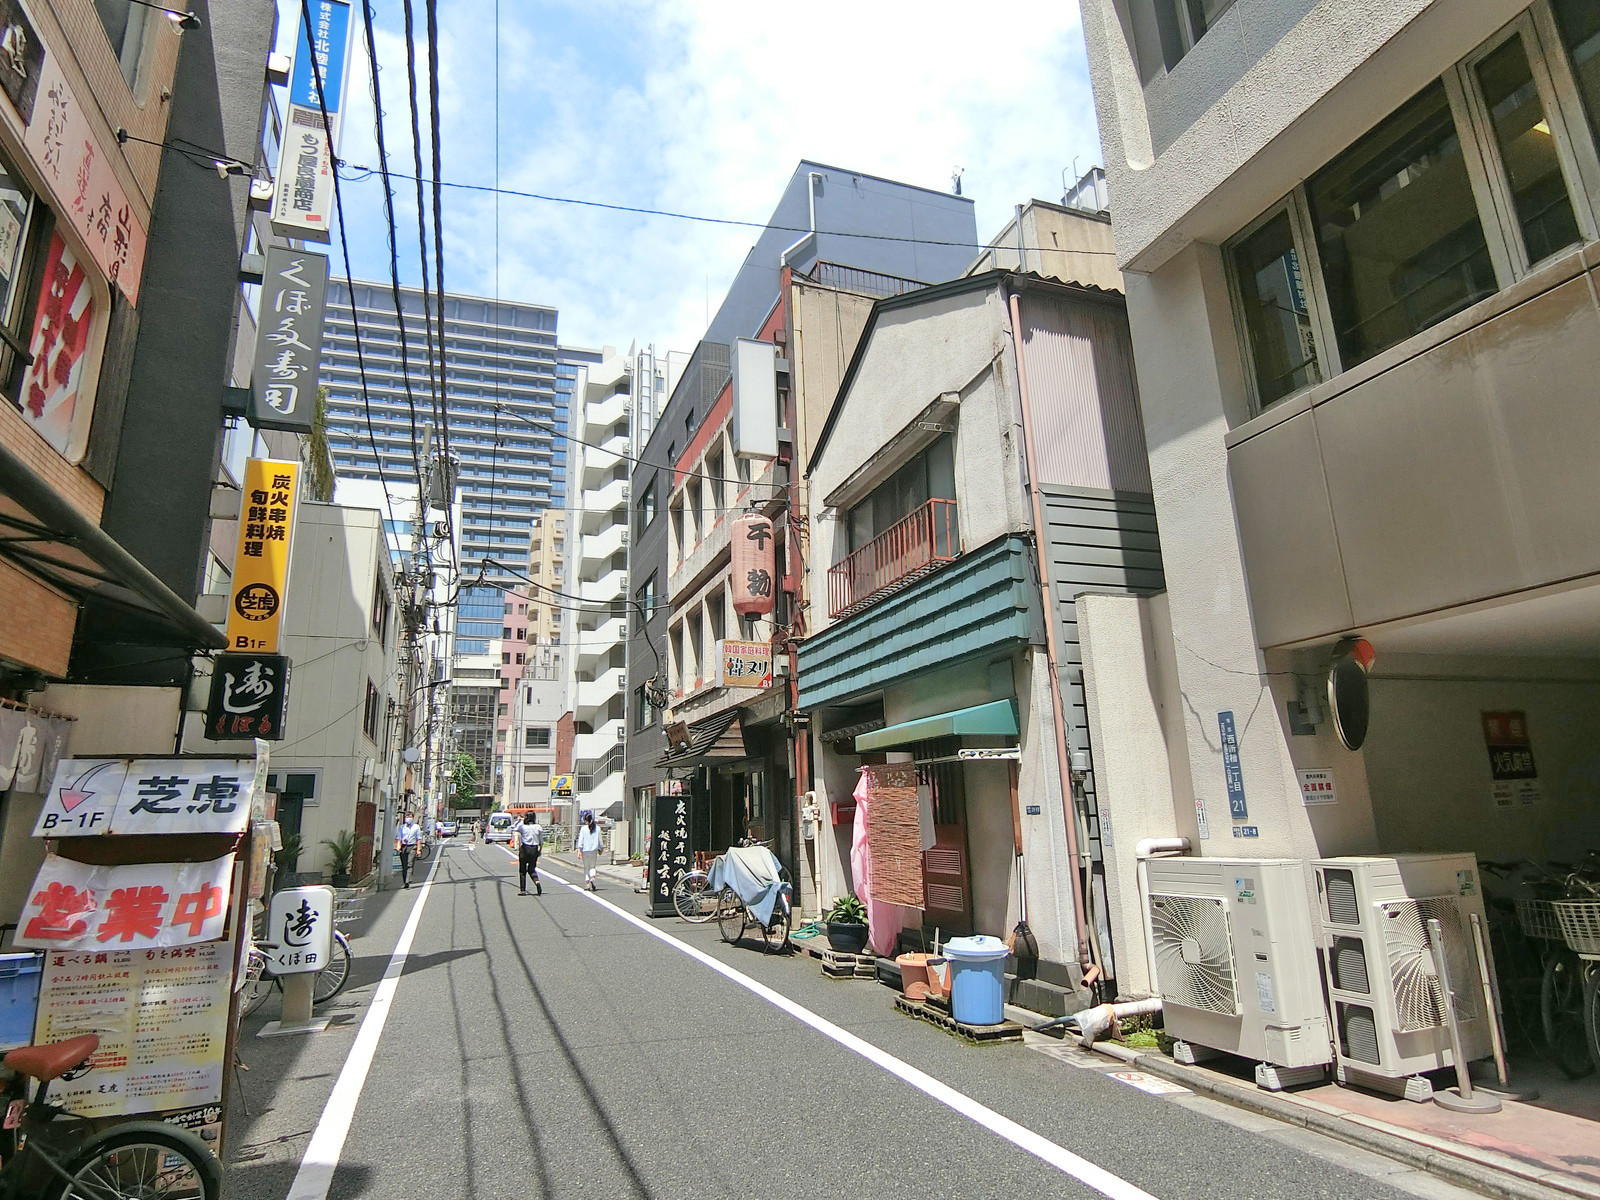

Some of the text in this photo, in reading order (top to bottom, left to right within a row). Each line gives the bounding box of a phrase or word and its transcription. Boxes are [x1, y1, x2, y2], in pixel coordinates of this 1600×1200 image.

[266, 474, 291, 541] 炭火串焼
[243, 489, 269, 557] 旬鮮料理
[747, 522, 772, 597] 干物
[241, 592, 274, 611] 芝虎
[235, 636, 267, 650] B1F
[724, 644, 769, 656] 韓国家庭料理
[129, 774, 241, 815] 芝虎
[1303, 782, 1332, 792] 全面禁煙
[1232, 800, 1245, 812] 21
[42, 811, 105, 831] B-1F
[24, 881, 223, 943] 営業中
[53, 953, 108, 966] 選べる鍋
[278, 951, 318, 967] くぼ田
